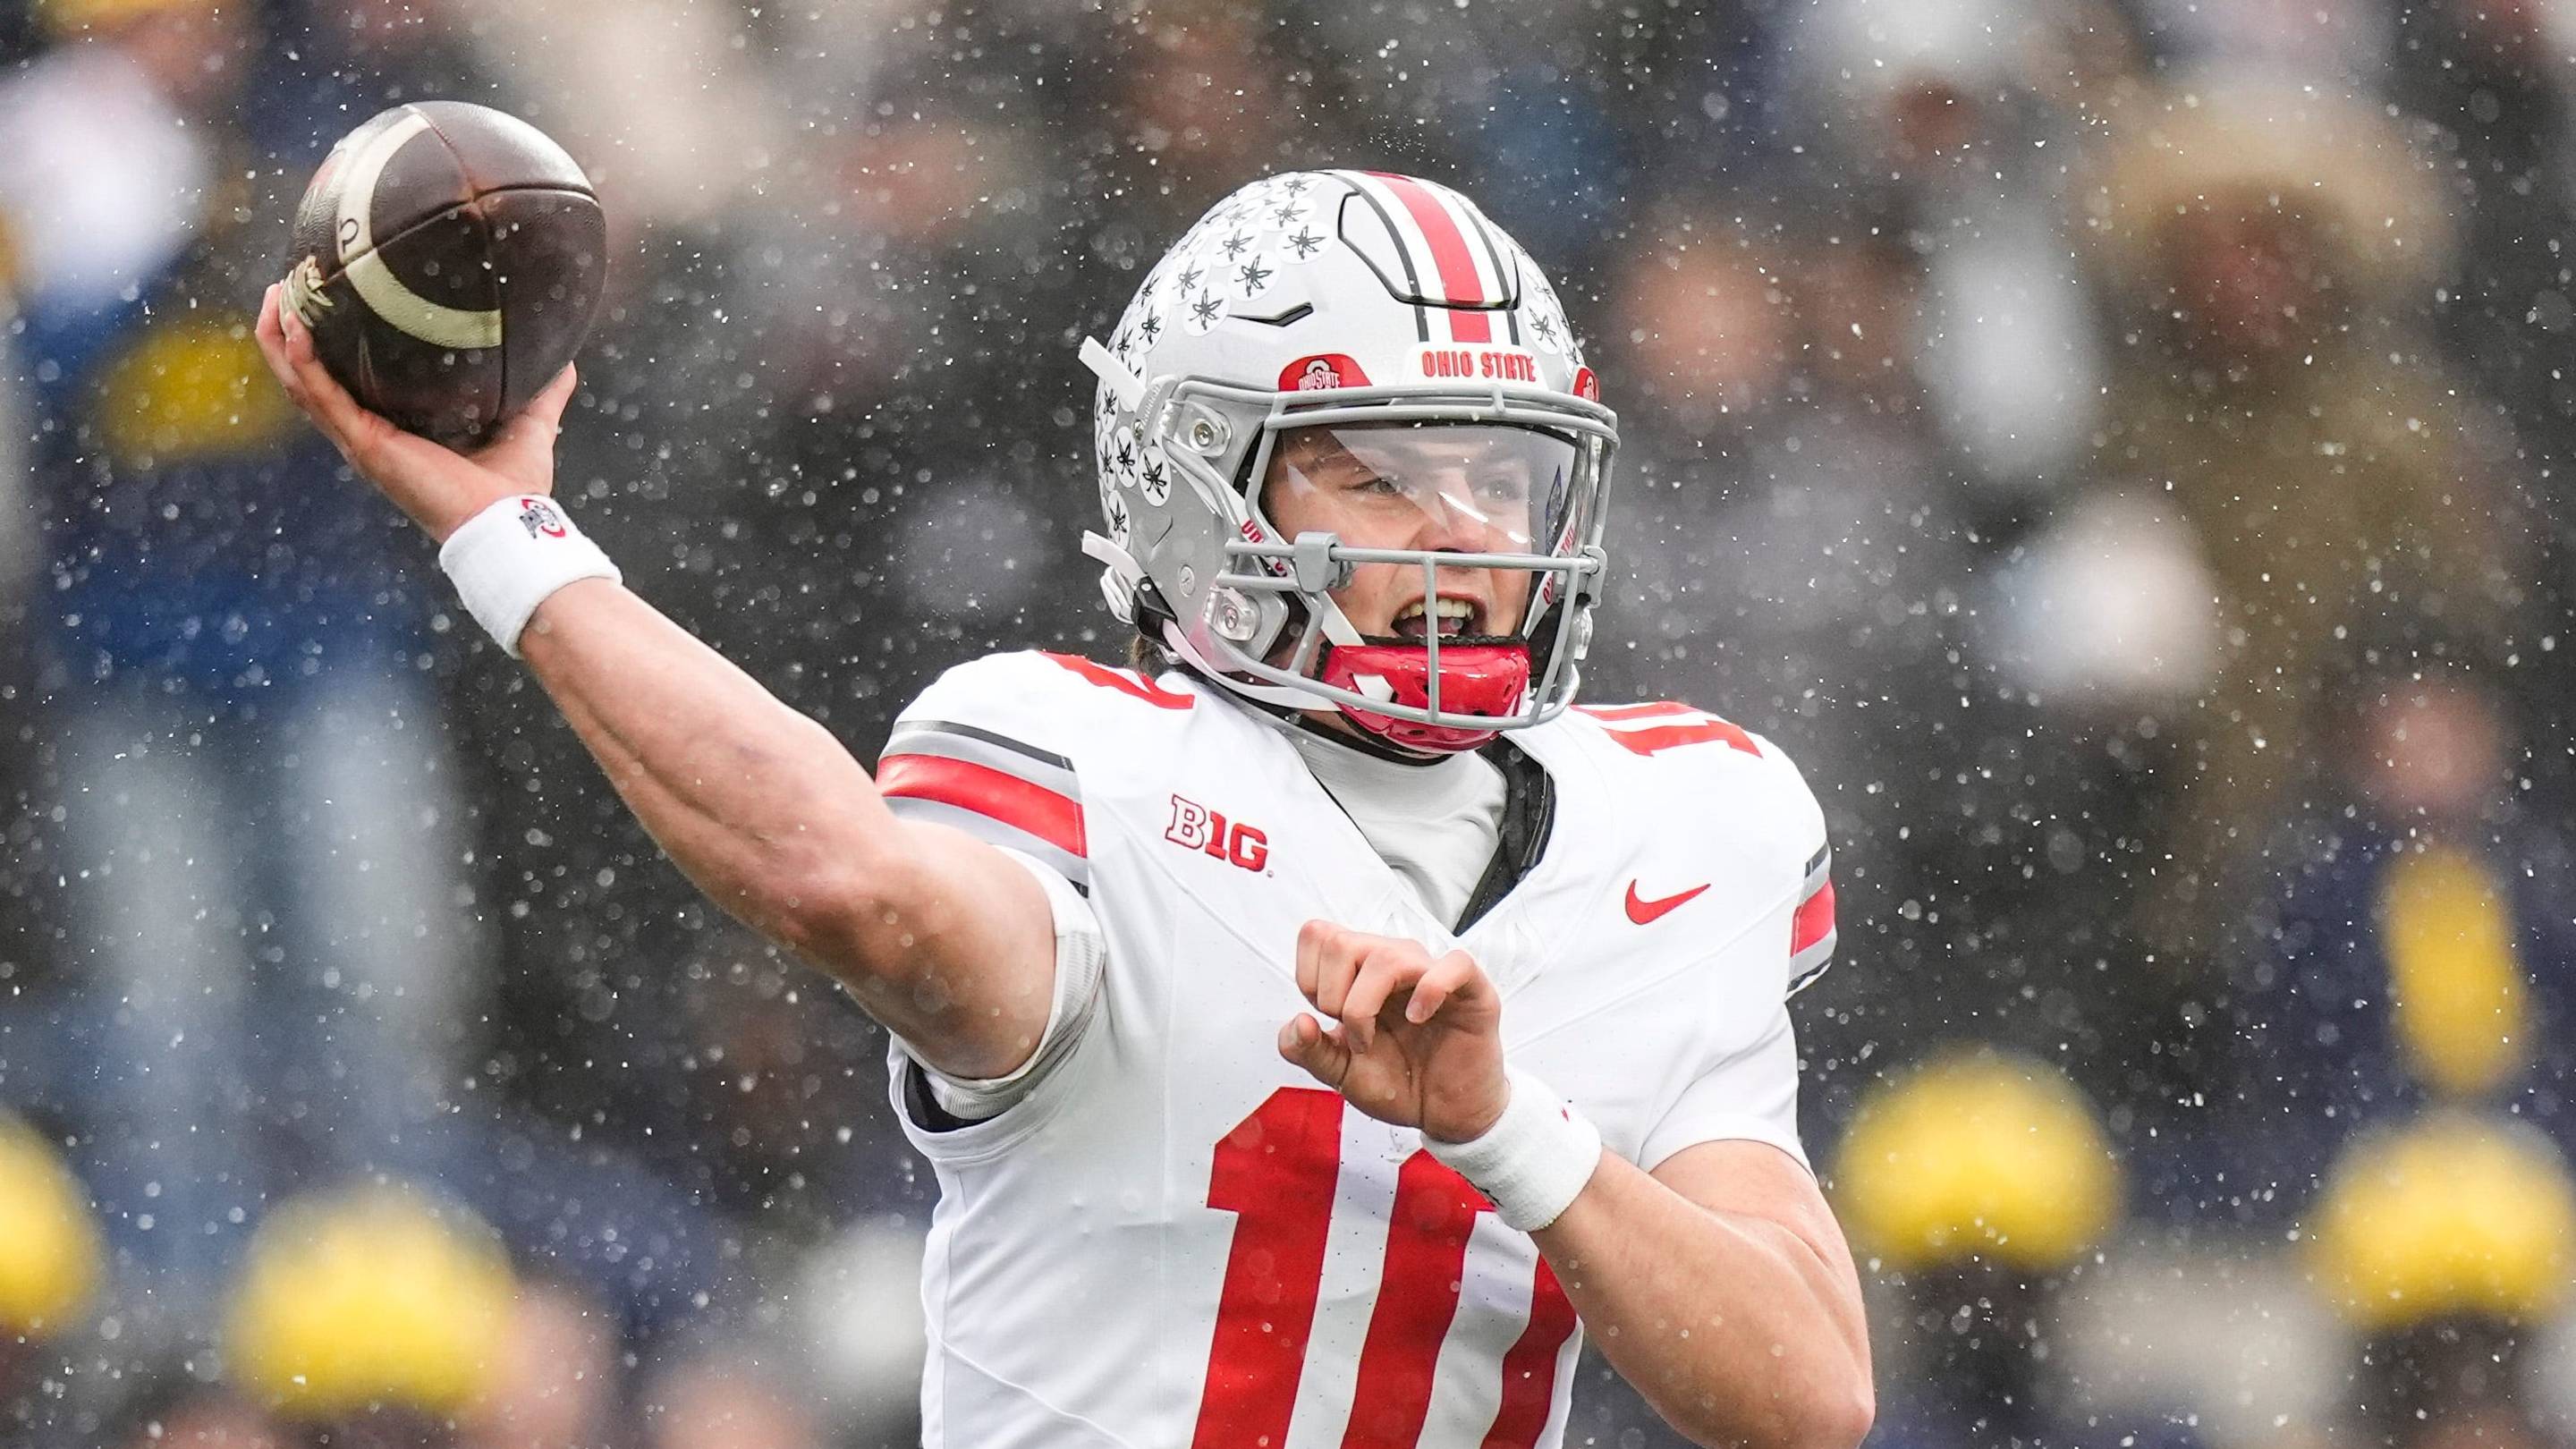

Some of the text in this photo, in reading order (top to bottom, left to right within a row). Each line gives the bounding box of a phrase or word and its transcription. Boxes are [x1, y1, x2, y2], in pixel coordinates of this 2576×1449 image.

[1422, 351, 1537, 382] OHIO STATE
[1191, 1086, 1578, 1449] 10
